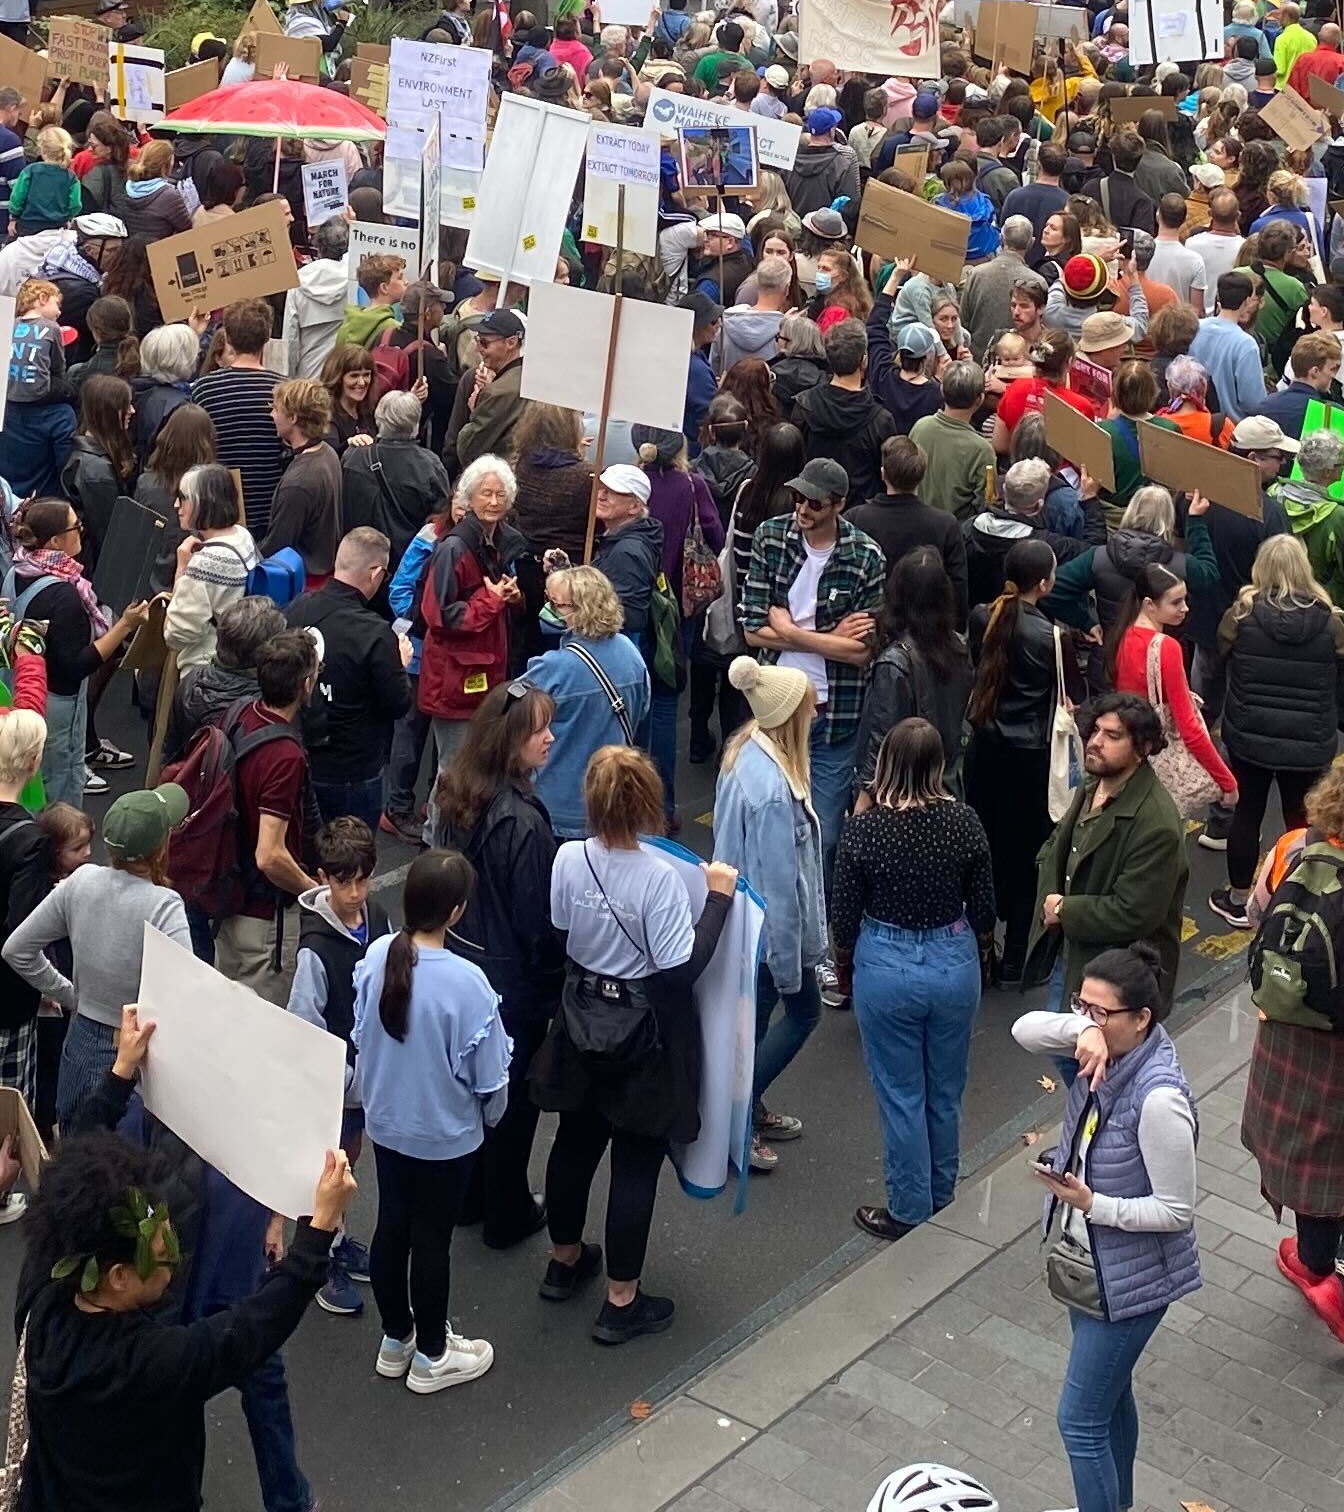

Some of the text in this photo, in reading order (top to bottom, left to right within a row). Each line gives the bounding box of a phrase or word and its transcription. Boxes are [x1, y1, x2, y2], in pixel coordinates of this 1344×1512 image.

[74, 22, 96, 35] STOP
[53, 32, 81, 47] FAST
[52, 48, 85, 61] PROFIT
[420, 52, 457, 68] NZFirst
[55, 62, 72, 76] THE
[398, 77, 473, 99] ENVIRONMENT
[422, 97, 447, 111] LAST
[677, 103, 731, 127] WAIHEKE
[596, 134, 651, 154] EXTRACT TODAY
[310, 169, 338, 181] MARCH
[587, 159, 659, 182] EXTINCT TOMORROW
[318, 179, 333, 188] FOR
[312, 187, 340, 199] NATURE
[353, 230, 416, 250] There is no
[1093, 368, 1109, 385] FOR
